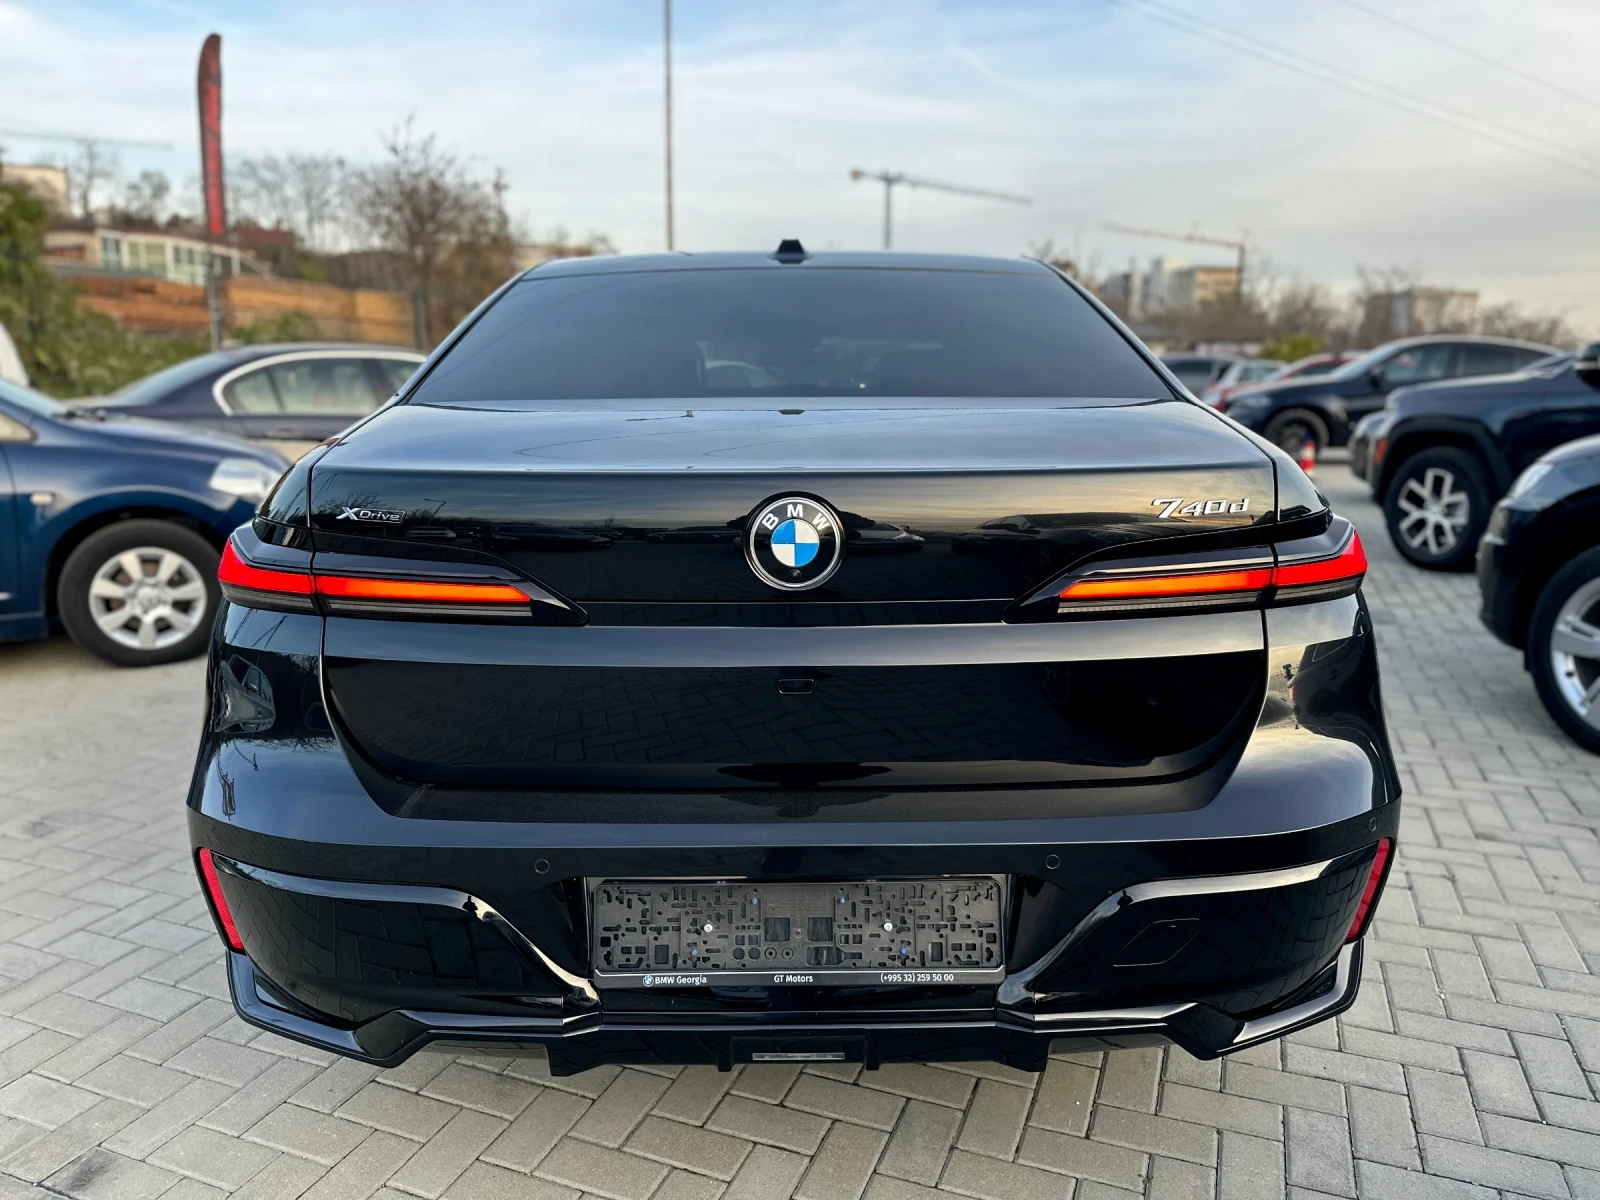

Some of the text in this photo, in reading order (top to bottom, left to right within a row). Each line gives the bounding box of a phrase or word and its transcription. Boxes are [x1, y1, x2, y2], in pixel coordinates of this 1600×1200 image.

[1151, 498, 1250, 518] 740d
[761, 503, 831, 531] BMW
[654, 975, 707, 985] BMW Georgia
[773, 974, 813, 983] GT Motors
[880, 973, 954, 983] (+995 32) 259 50 00
